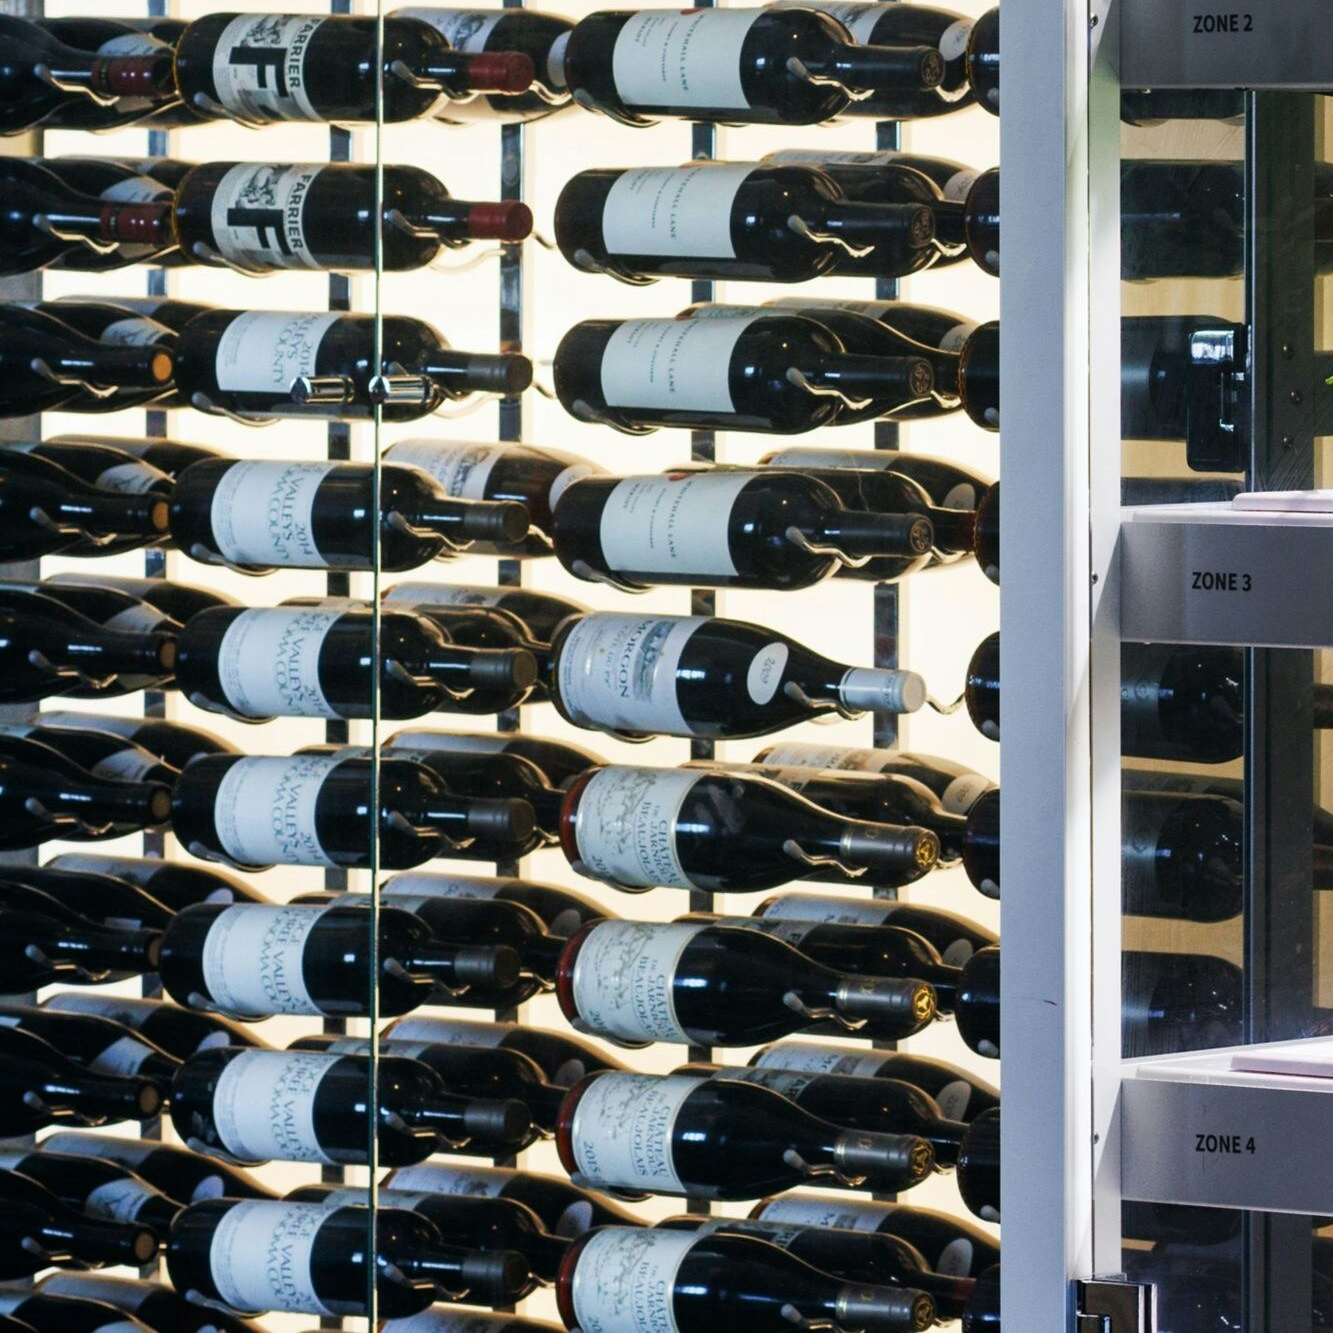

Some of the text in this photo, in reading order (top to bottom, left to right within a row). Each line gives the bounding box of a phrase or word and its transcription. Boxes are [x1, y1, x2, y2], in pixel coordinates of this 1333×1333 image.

[287, 17, 321, 89] FARRIER
[1193, 14, 1254, 33] ZONE 2
[680, 66, 689, 92] LANE
[285, 174, 311, 249] FARRIER
[282, 477, 304, 541] VALLEYS
[294, 524, 313, 556] 2014
[667, 534, 676, 557] LANE
[1192, 571, 1252, 592] ZONE 3
[289, 637, 305, 701] VALLEYS
[619, 620, 653, 698] MORGON
[285, 784, 303, 849] VALLEYS
[584, 1142, 601, 1174] 2015
[633, 1090, 658, 1176] BEAUJOLAIS
[645, 1109, 660, 1177] JARNIOUX
[655, 1106, 671, 1179] CHÂTEAU
[1195, 1134, 1256, 1155] ZONE 4
